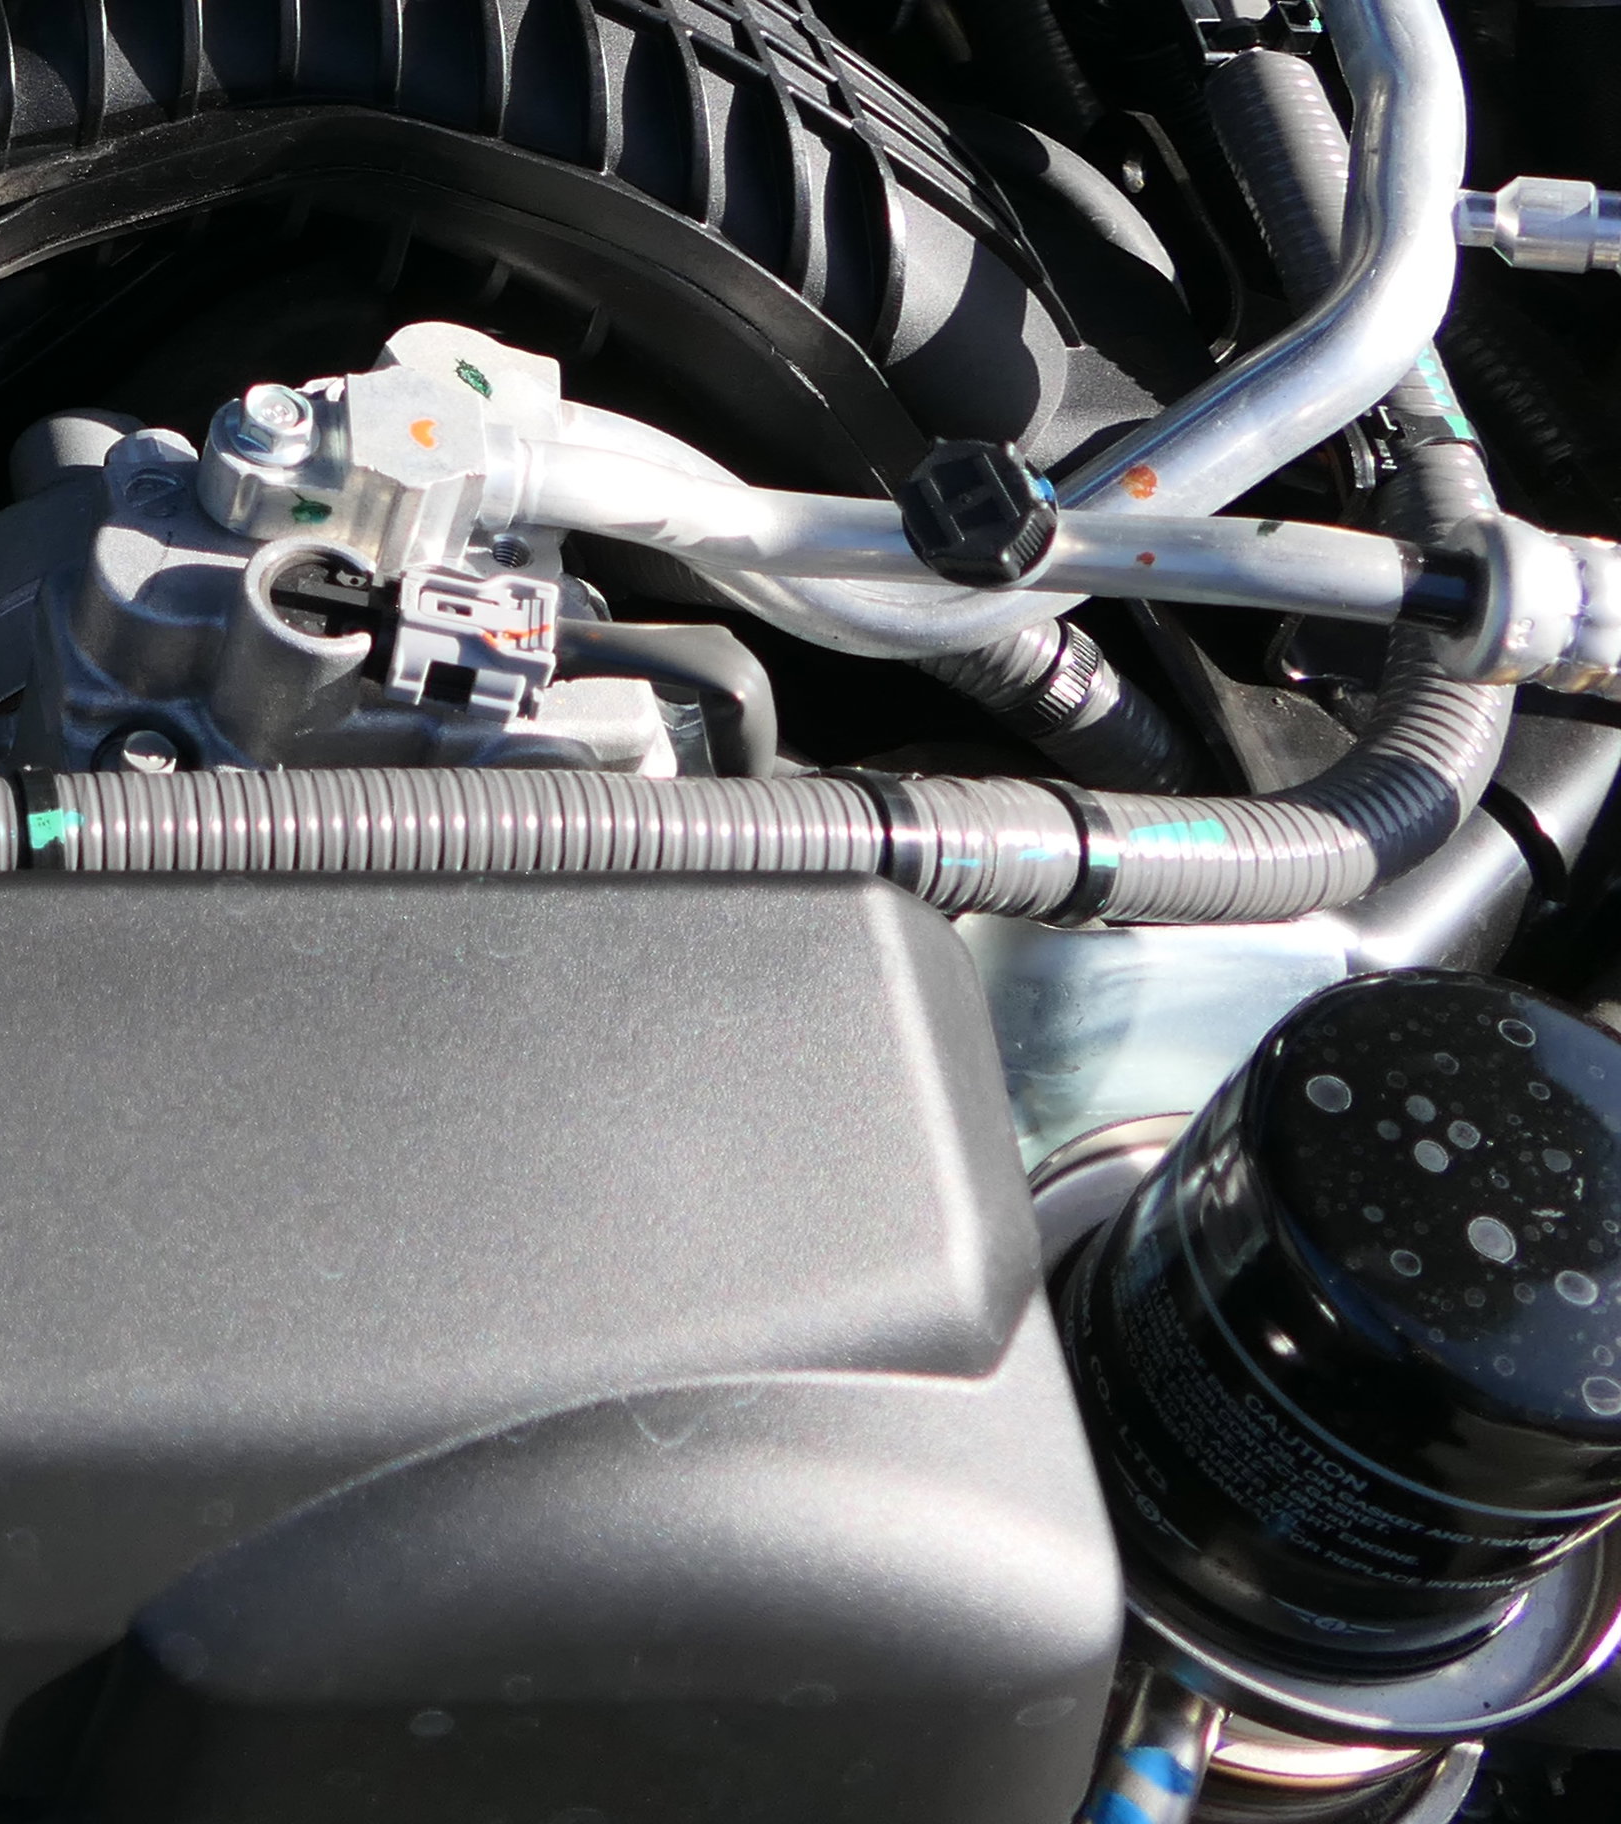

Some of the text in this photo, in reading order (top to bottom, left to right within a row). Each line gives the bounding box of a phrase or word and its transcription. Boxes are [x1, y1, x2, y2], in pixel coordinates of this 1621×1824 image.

[1205, 1370, 1269, 1444] ENGINE
[1265, 1439, 1303, 1471] OIL
[1300, 1466, 1337, 1492] ON
[1335, 1487, 1426, 1533] GASKET
[1423, 1525, 1476, 1545] AND
[1217, 1405, 1304, 1486] CONTACT
[1241, 1388, 1371, 1493] CAUTION
[1267, 1487, 1337, 1534] START
[1321, 1547, 1422, 1588] REPLACE
